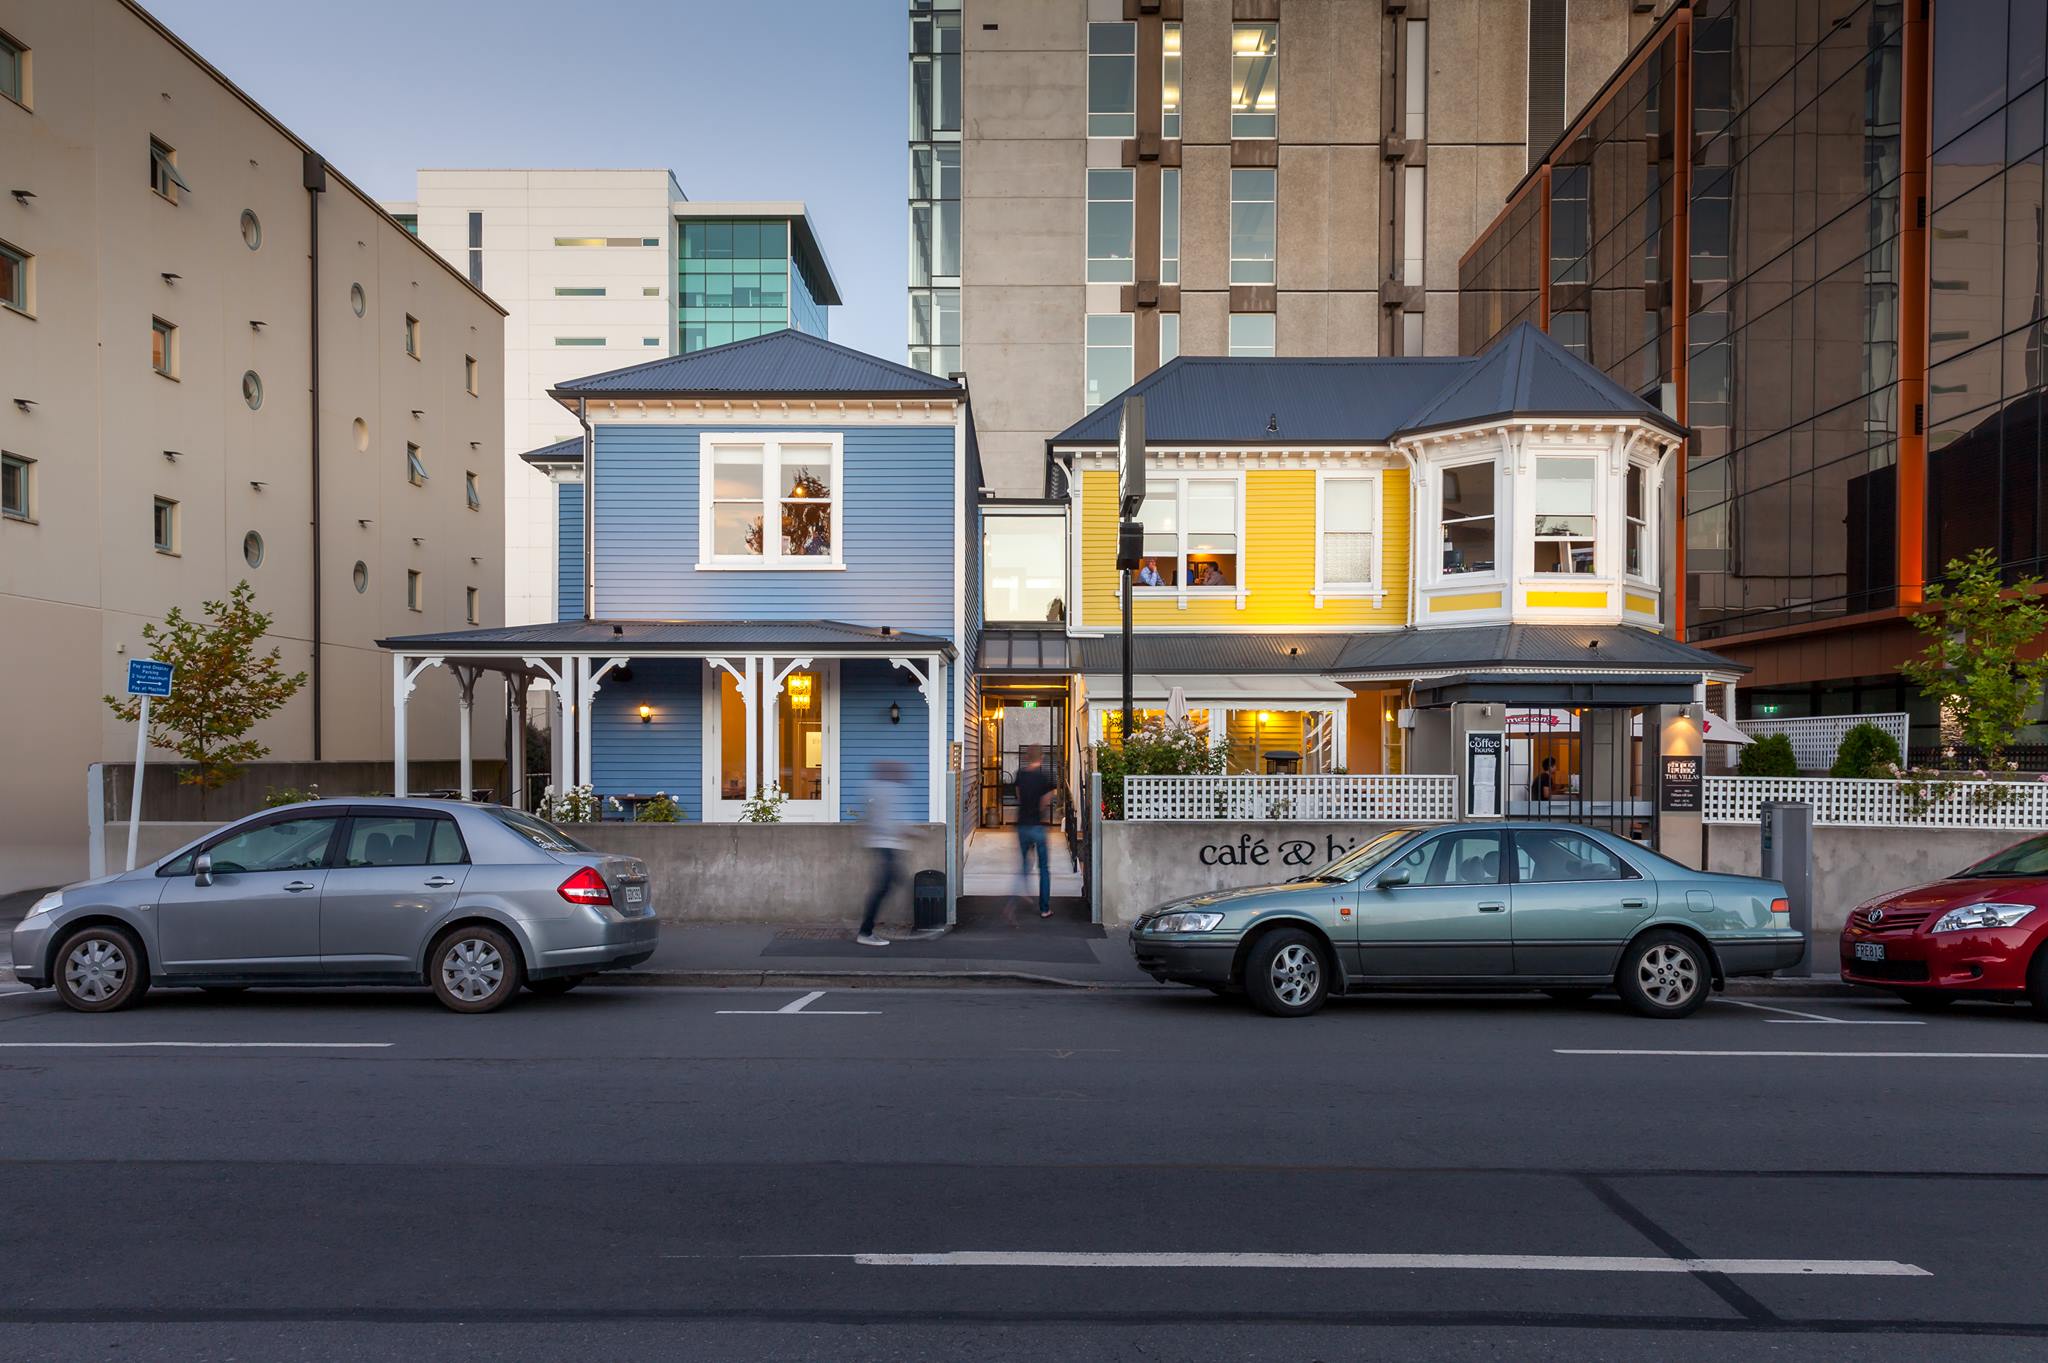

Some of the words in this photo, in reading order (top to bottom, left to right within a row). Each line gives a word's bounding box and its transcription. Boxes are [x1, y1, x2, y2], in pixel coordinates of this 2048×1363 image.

[1469, 738, 1500, 748] coffee
[1199, 833, 1270, 866] café
[1278, 840, 1316, 866] &
[1855, 944, 1884, 958] FRE813
